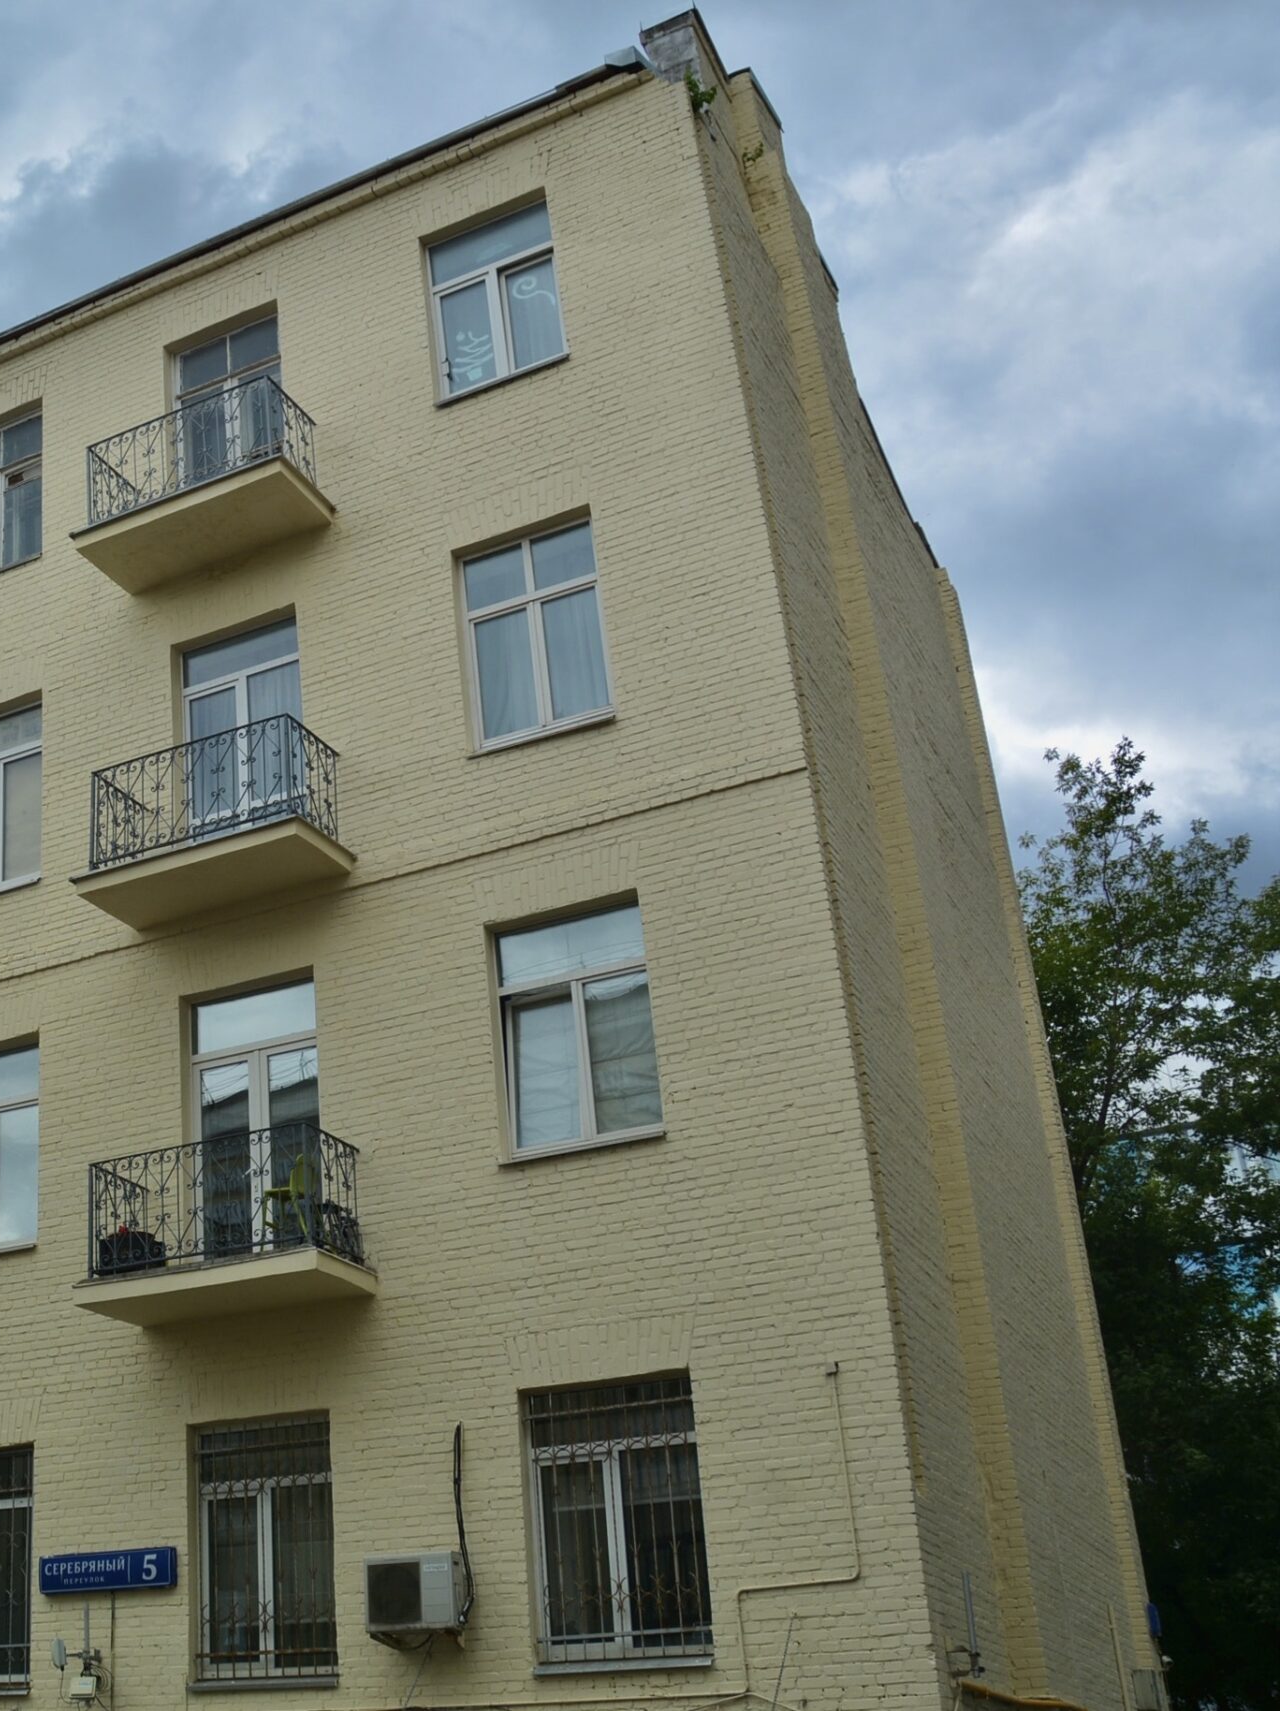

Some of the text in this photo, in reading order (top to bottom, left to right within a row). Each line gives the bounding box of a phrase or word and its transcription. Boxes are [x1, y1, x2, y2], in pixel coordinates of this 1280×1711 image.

[44, 1556, 126, 1576] СЕРЕБРЯНЫЙ
[142, 1553, 158, 1581] 5
[63, 1577, 105, 1585] ПЕРЕУЛОК
